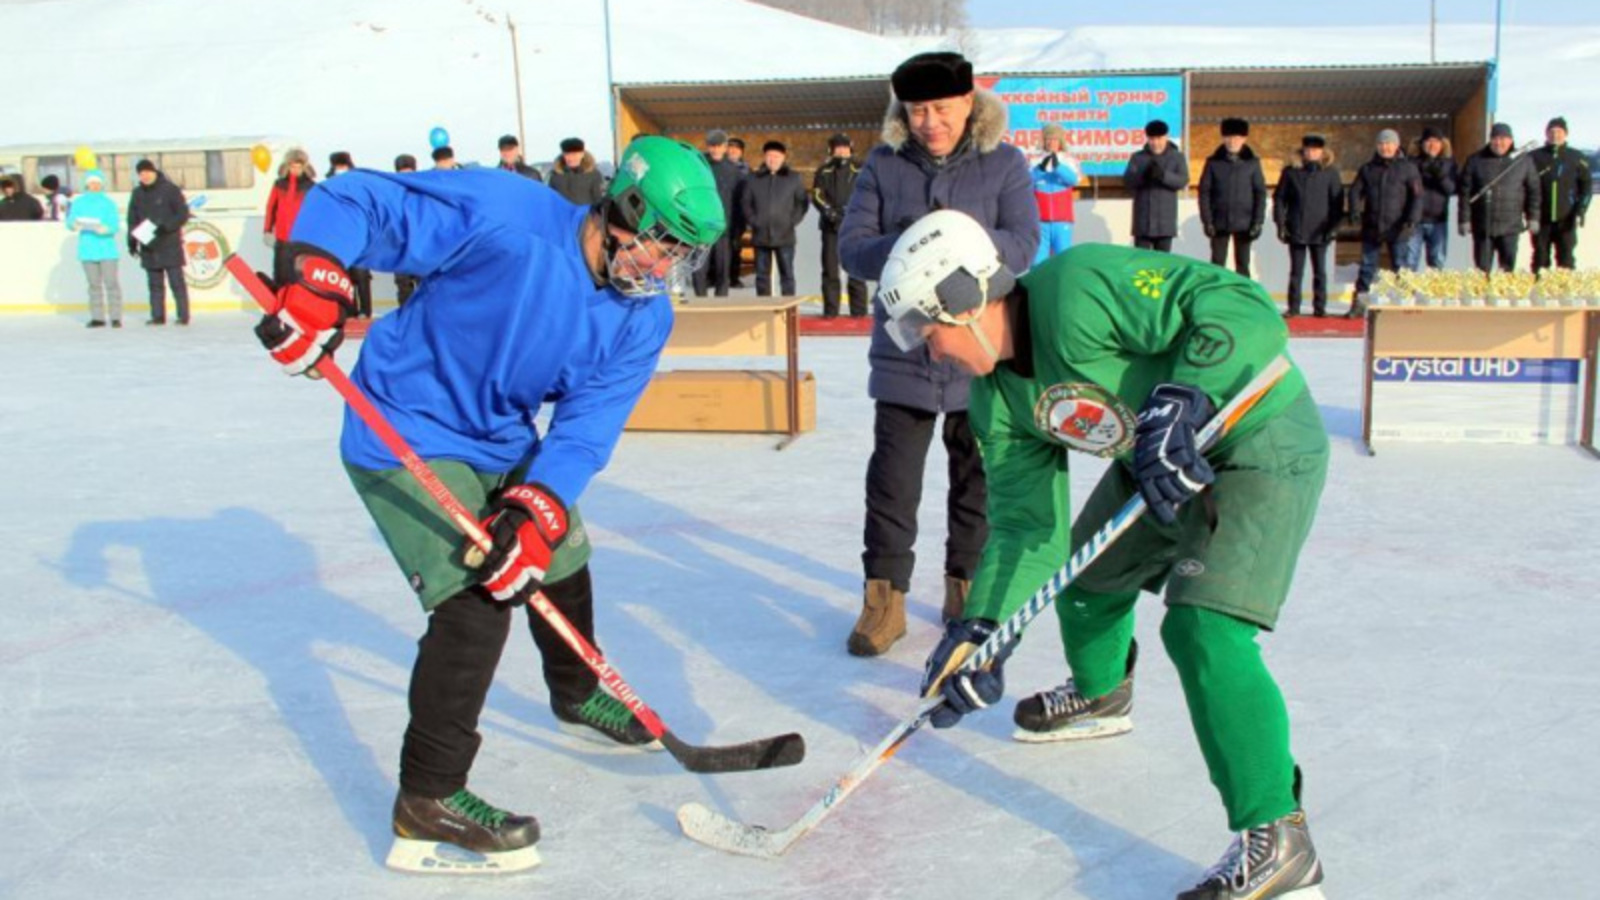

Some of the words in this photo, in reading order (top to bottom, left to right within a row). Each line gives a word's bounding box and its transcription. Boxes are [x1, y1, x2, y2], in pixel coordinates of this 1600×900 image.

[1001, 88, 1089, 103] ккейный
[1097, 90, 1166, 105] турнир
[1038, 109, 1109, 121] памяти
[1373, 356, 1463, 382] Crystal
[1470, 357, 1519, 377] UHD
